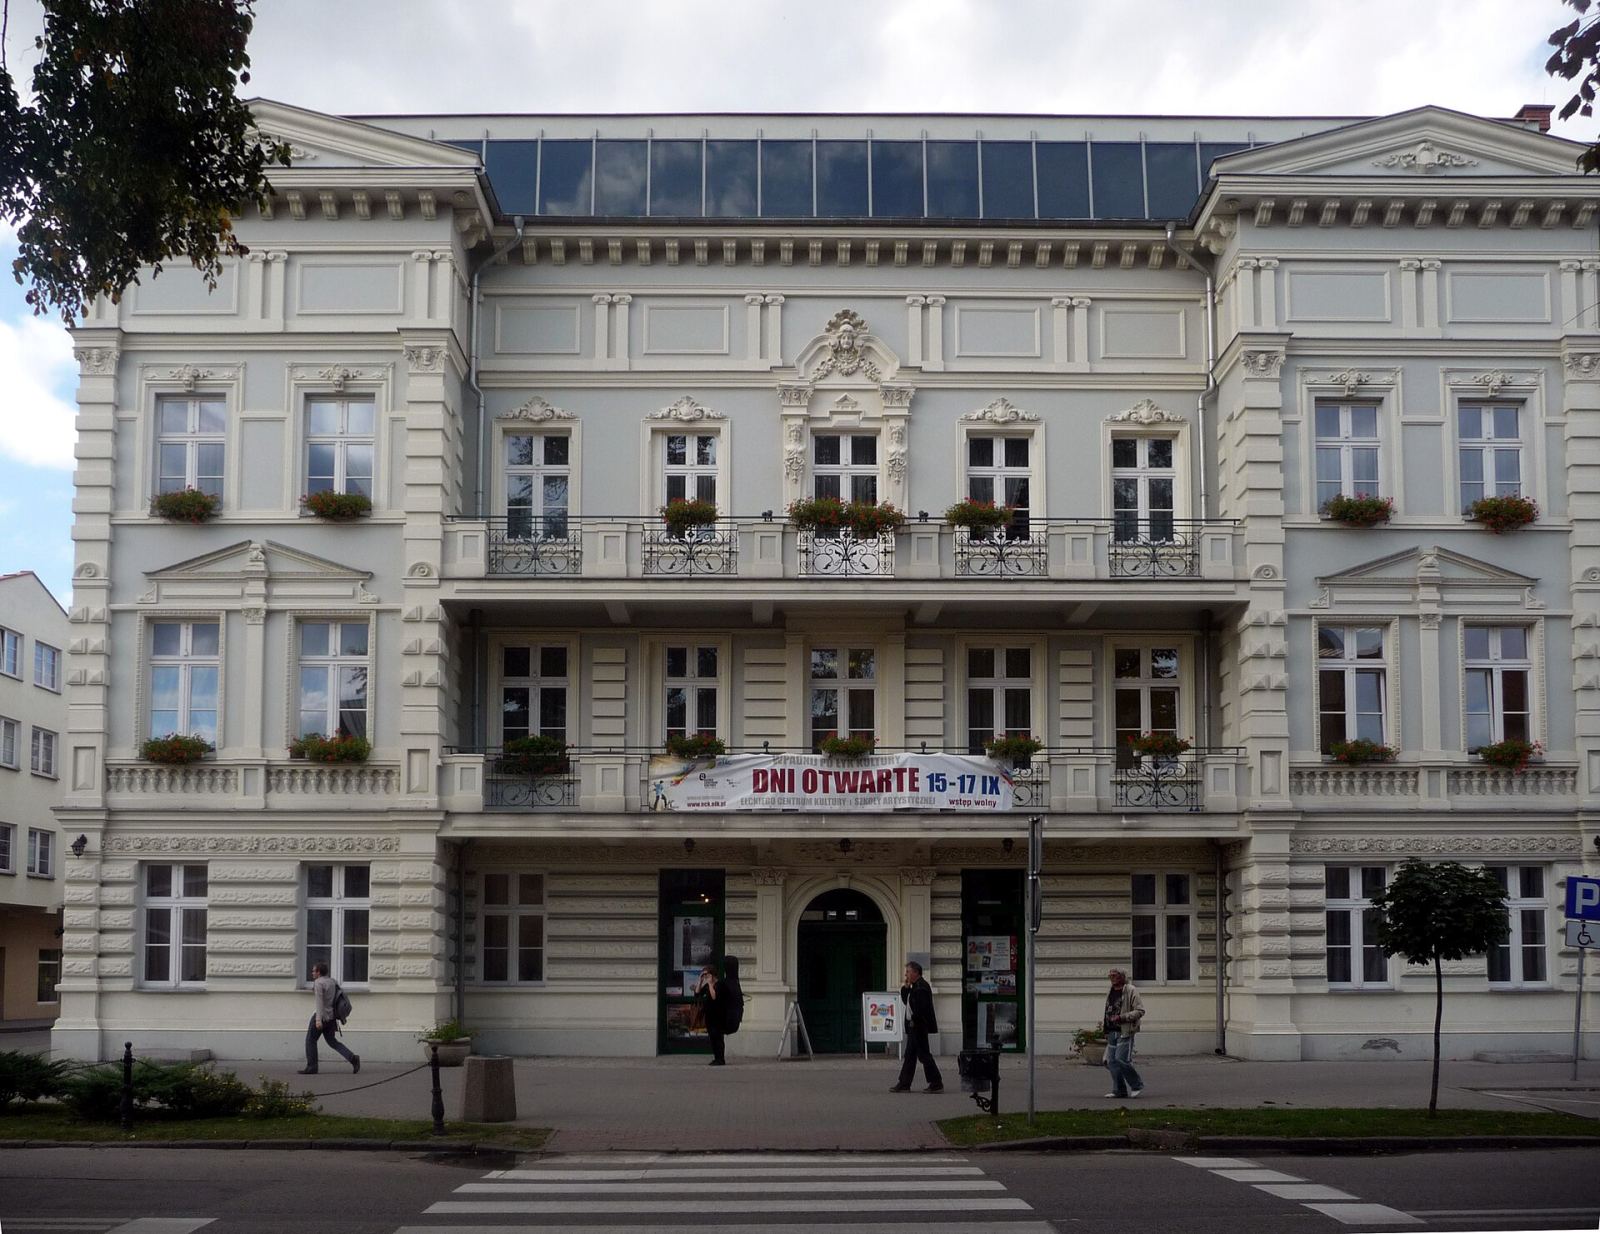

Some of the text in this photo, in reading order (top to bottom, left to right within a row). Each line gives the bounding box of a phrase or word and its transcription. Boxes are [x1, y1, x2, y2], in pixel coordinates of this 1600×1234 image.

[856, 755, 900, 768] KULTURY
[753, 767, 1000, 795] DNI OTWARTE 15-17 IX
[740, 797, 776, 806] EŁCKIEGO
[777, 797, 813, 806] CENTRUM
[814, 797, 847, 806] KULTURY
[854, 797, 882, 806] SZKOŁY
[882, 796, 936, 806] ARTYSTYCZNEJ
[949, 798, 997, 808] wstęp wolny
[1575, 882, 1600, 914] P
